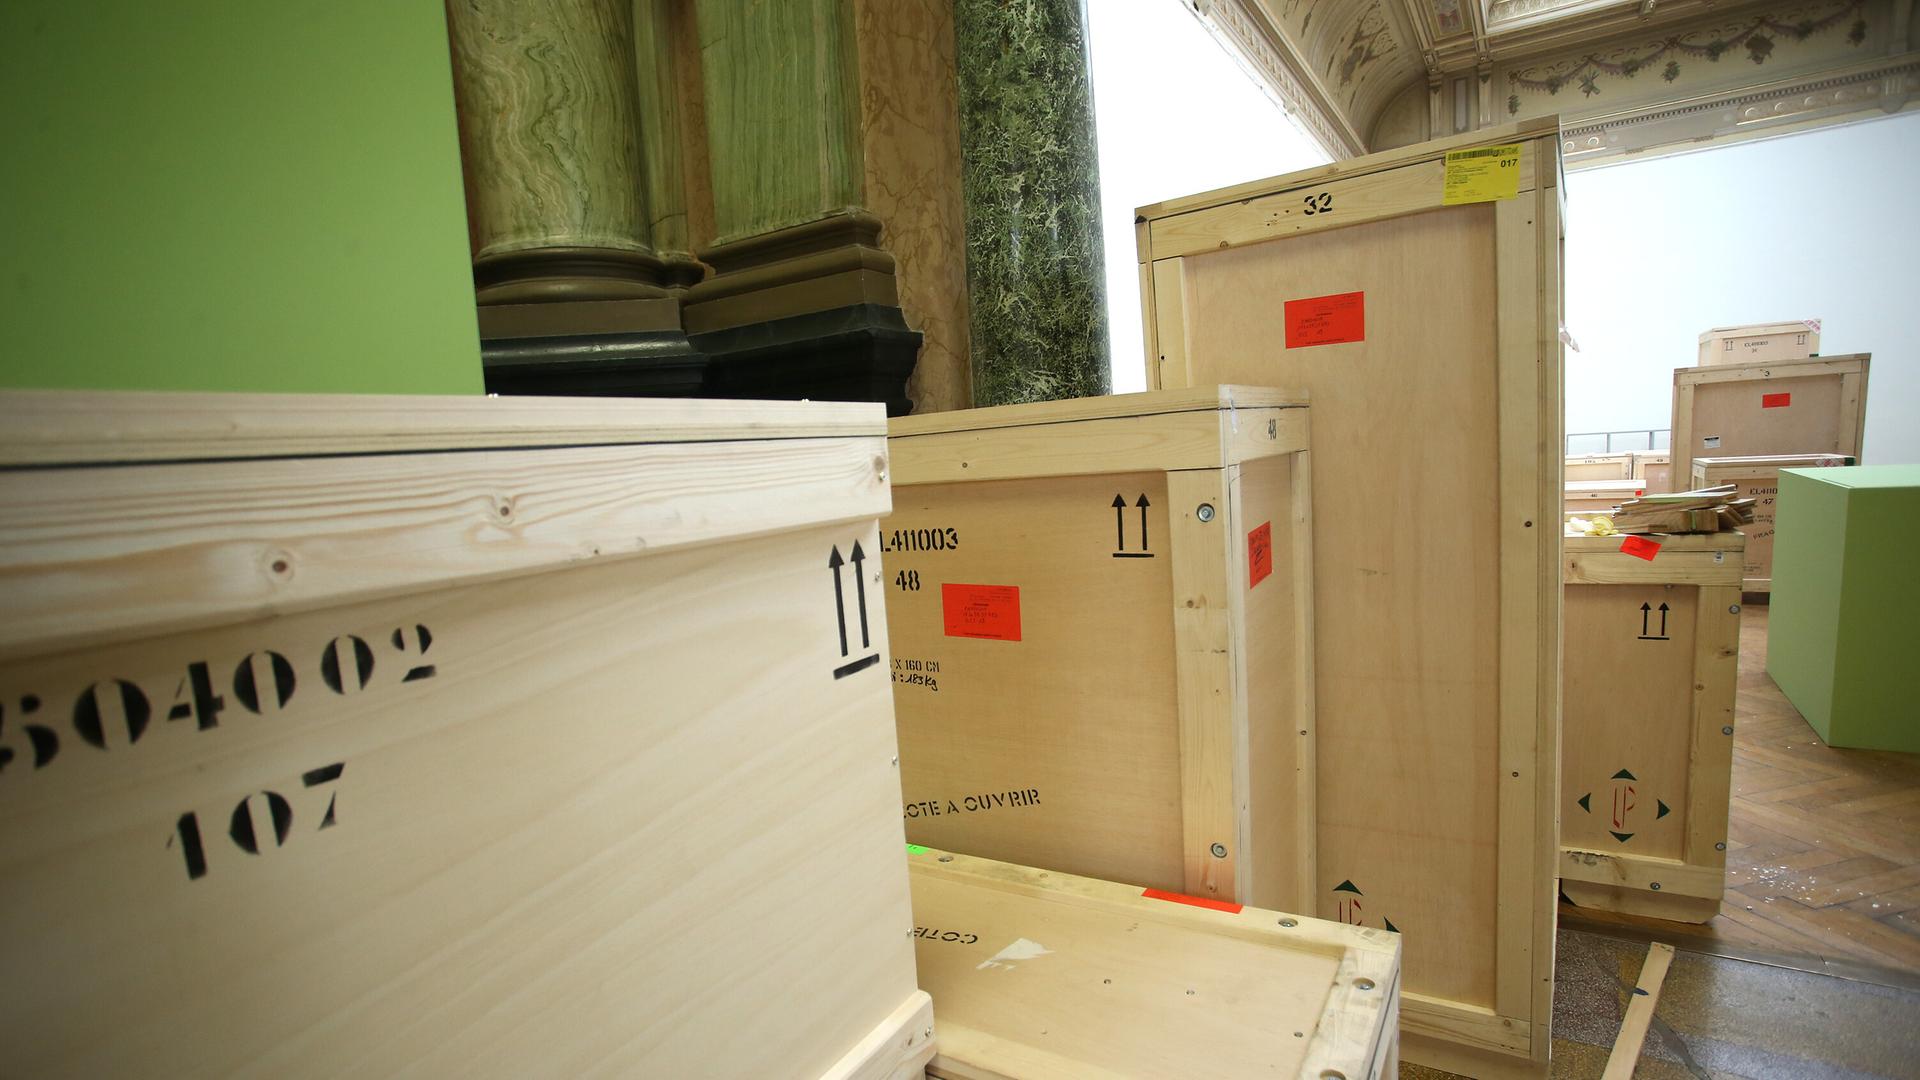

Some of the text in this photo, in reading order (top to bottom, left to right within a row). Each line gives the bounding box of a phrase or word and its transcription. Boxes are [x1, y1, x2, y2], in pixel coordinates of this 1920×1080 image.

[1500, 159, 1518, 168] 017
[1303, 192, 1333, 216] 32
[1268, 418, 1277, 440] 48
[895, 570, 921, 592] 48
[895, 658, 902, 670] X
[905, 659, 922, 671] 160
[903, 788, 1041, 819] OTE A OUVRIR
[166, 761, 347, 881] 107
